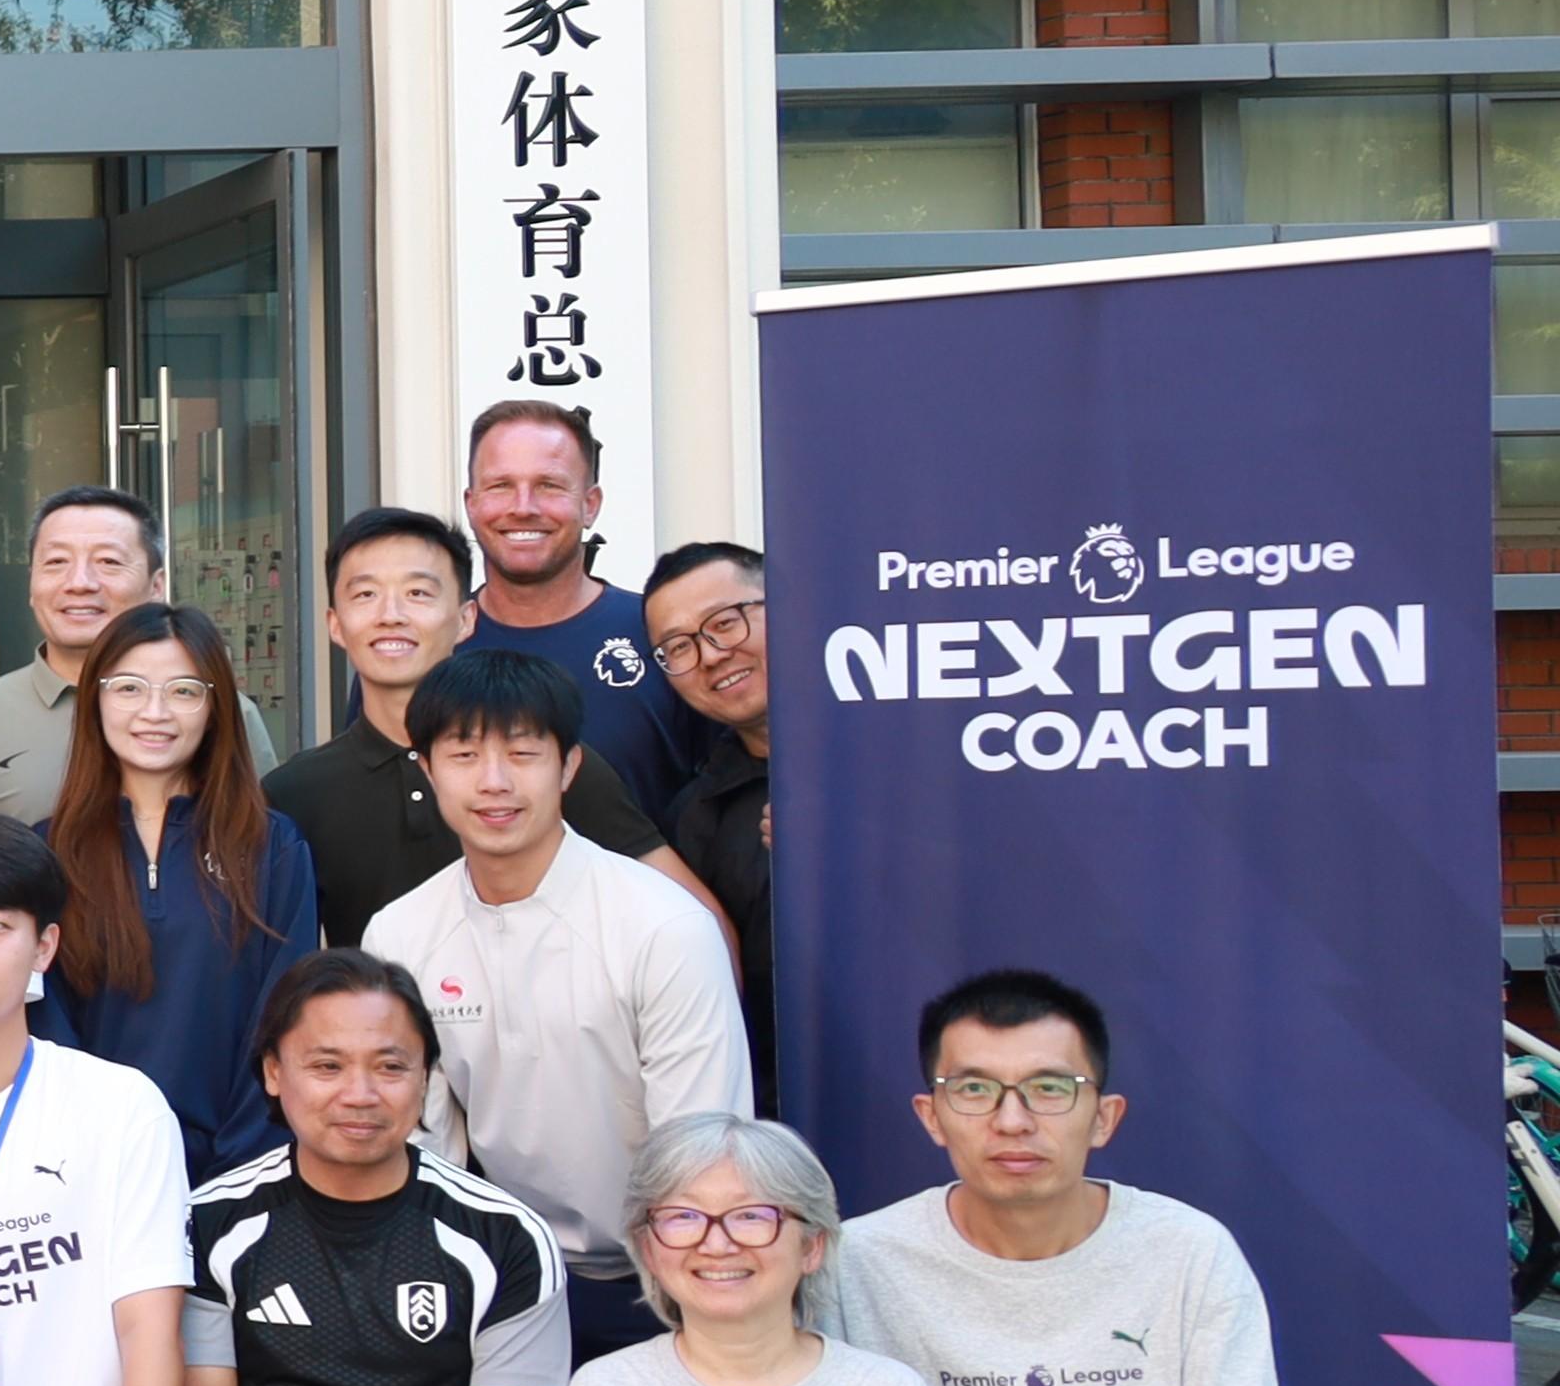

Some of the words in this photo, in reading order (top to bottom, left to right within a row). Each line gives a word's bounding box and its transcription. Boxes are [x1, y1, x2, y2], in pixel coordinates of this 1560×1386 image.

[878, 547, 1058, 591] Premier
[1157, 536, 1355, 586] League
[823, 603, 1426, 702] NEXTGEN
[961, 706, 1269, 773] COACH
